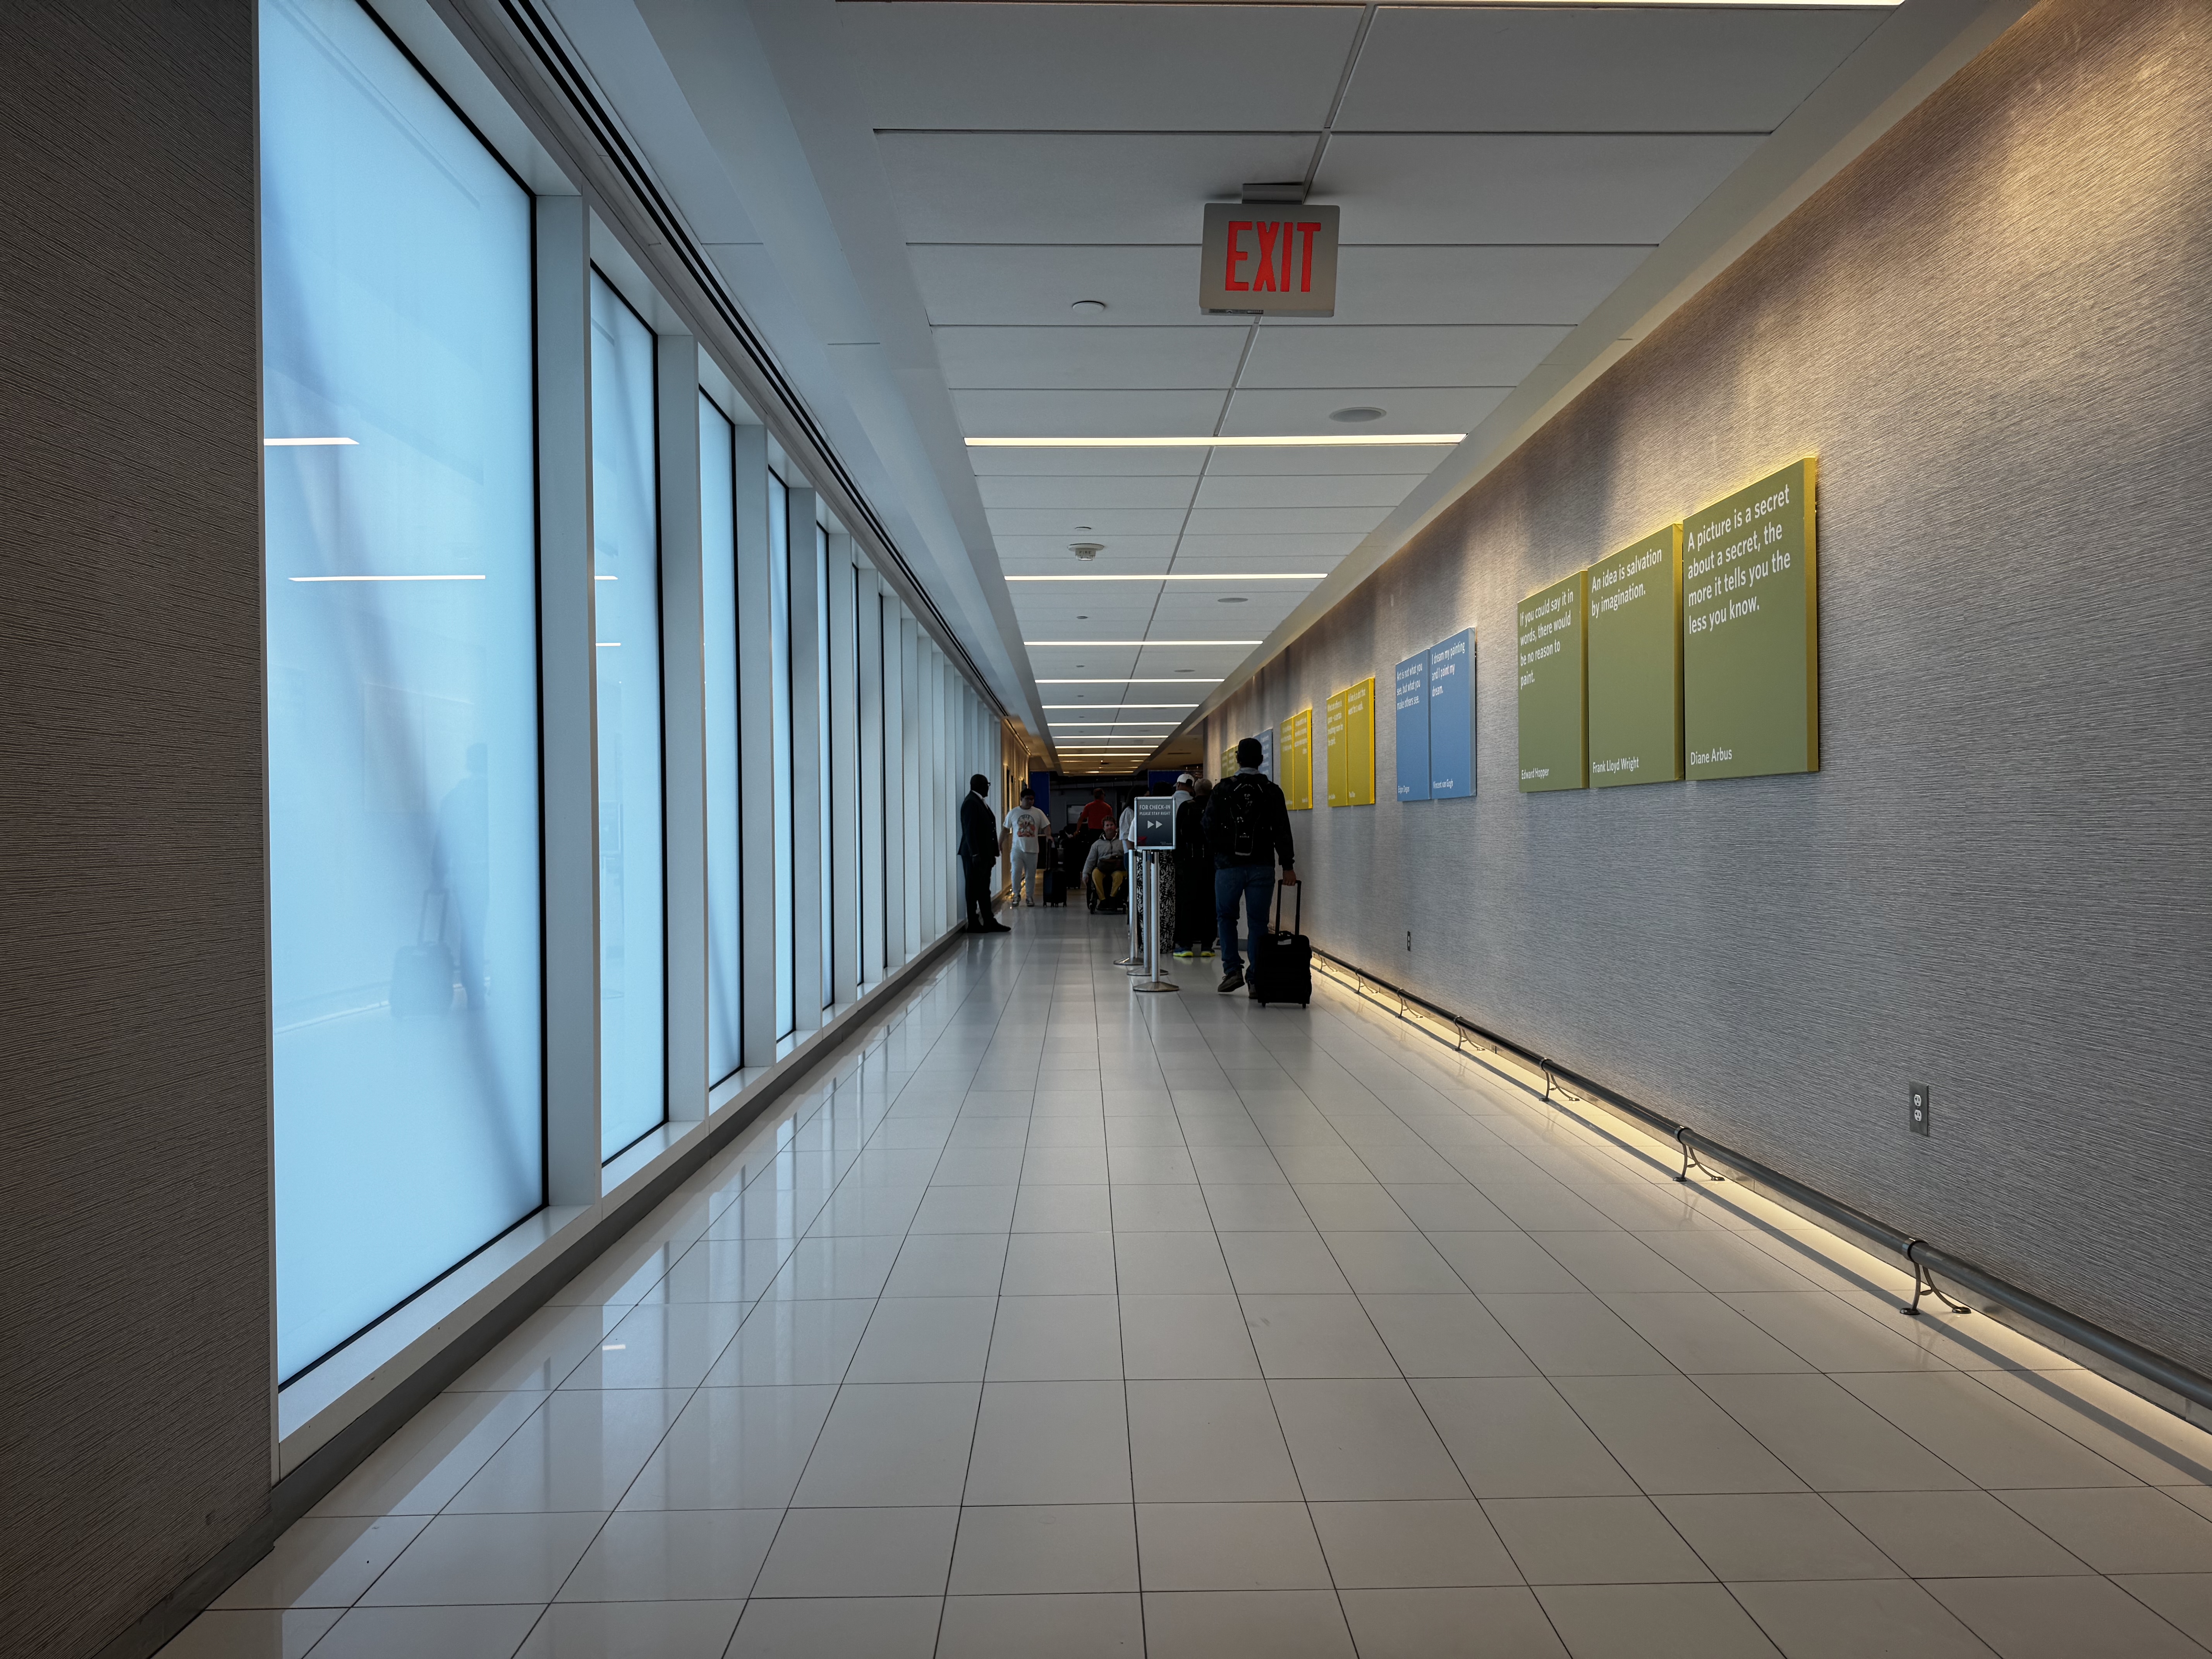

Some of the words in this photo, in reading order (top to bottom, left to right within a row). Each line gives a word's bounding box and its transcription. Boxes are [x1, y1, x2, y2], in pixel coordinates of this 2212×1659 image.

[1225, 221, 1321, 292] EXIT
[1688, 532, 1695, 552] A
[1698, 518, 1731, 551] picture
[1734, 508, 1742, 528] is
[1745, 507, 1751, 523] a
[1755, 484, 1789, 518] secret
[1688, 551, 1714, 579] about
[1717, 551, 1722, 566] a
[1726, 530, 1760, 562] secret,
[1764, 522, 1782, 544] the
[1592, 576, 1601, 593] An
[1603, 568, 1617, 587] idea
[1619, 564, 1625, 580] is
[1627, 548, 1662, 577] salvation
[1689, 585, 1712, 606] more
[1715, 576, 1721, 596] it
[1724, 566, 1746, 592] tells
[1749, 561, 1768, 587] you
[1772, 550, 1790, 573] the
[1520, 611, 1524, 626] If
[1525, 610, 1534, 627] you
[1535, 598, 1549, 618] could
[1551, 597, 1561, 611] say
[1562, 591, 1566, 606] it
[1568, 588, 1573, 604] in
[1592, 600, 1599, 618] by
[1601, 583, 1645, 612] imagination.
[1689, 615, 1707, 634] less
[1709, 608, 1726, 632] you
[1729, 596, 1759, 620] know.
[1520, 627, 1537, 646] words,
[1538, 623, 1552, 638] there
[1554, 610, 1571, 631] would
[1434, 653, 1444, 664] dream
[1444, 649, 1450, 660] my
[1450, 641, 1465, 659] painting
[1520, 653, 1526, 666] be
[1528, 652, 1534, 664] no
[1535, 643, 1553, 661] reason
[1554, 639, 1560, 653] to
[1441, 664, 1449, 680] paint
[1449, 664, 1455, 675] my
[1521, 670, 1535, 690] paint.
[1432, 685, 1443, 697] dream.
[1522, 768, 1534, 779] Edward
[1535, 768, 1549, 779] Hopper
[1593, 761, 1606, 773] Frank
[1607, 759, 1620, 773] Lloyd
[1621, 756, 1639, 771] Wright
[1691, 751, 1709, 765] Diane
[1711, 747, 1732, 762] Arbus
